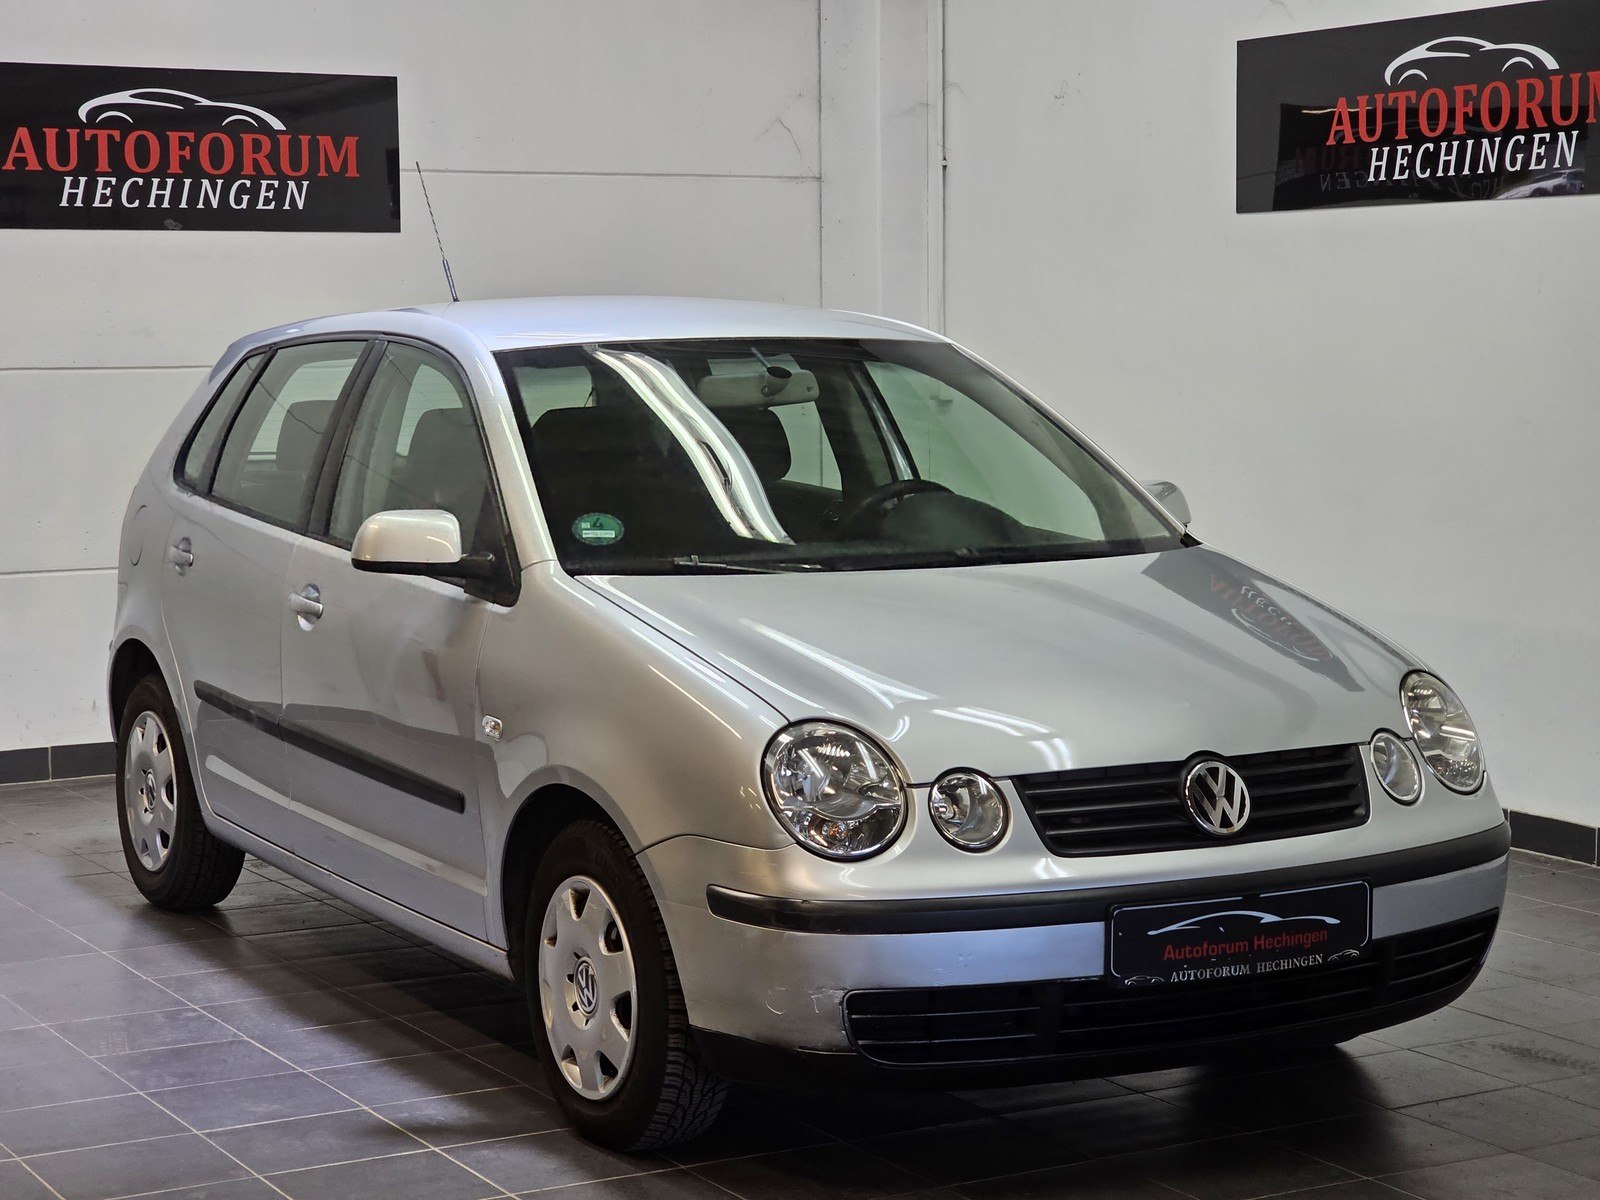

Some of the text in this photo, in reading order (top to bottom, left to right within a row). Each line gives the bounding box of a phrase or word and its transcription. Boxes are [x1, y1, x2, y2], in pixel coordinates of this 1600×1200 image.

[2, 126, 360, 178] AUTOFORUM
[1368, 130, 1580, 182] HECHINGEN
[59, 176, 310, 210] HECHINGEN
[1164, 930, 1328, 960] Autoforum Hechingen
[1171, 954, 1323, 982] AUTOFORUM HECHINGEN
